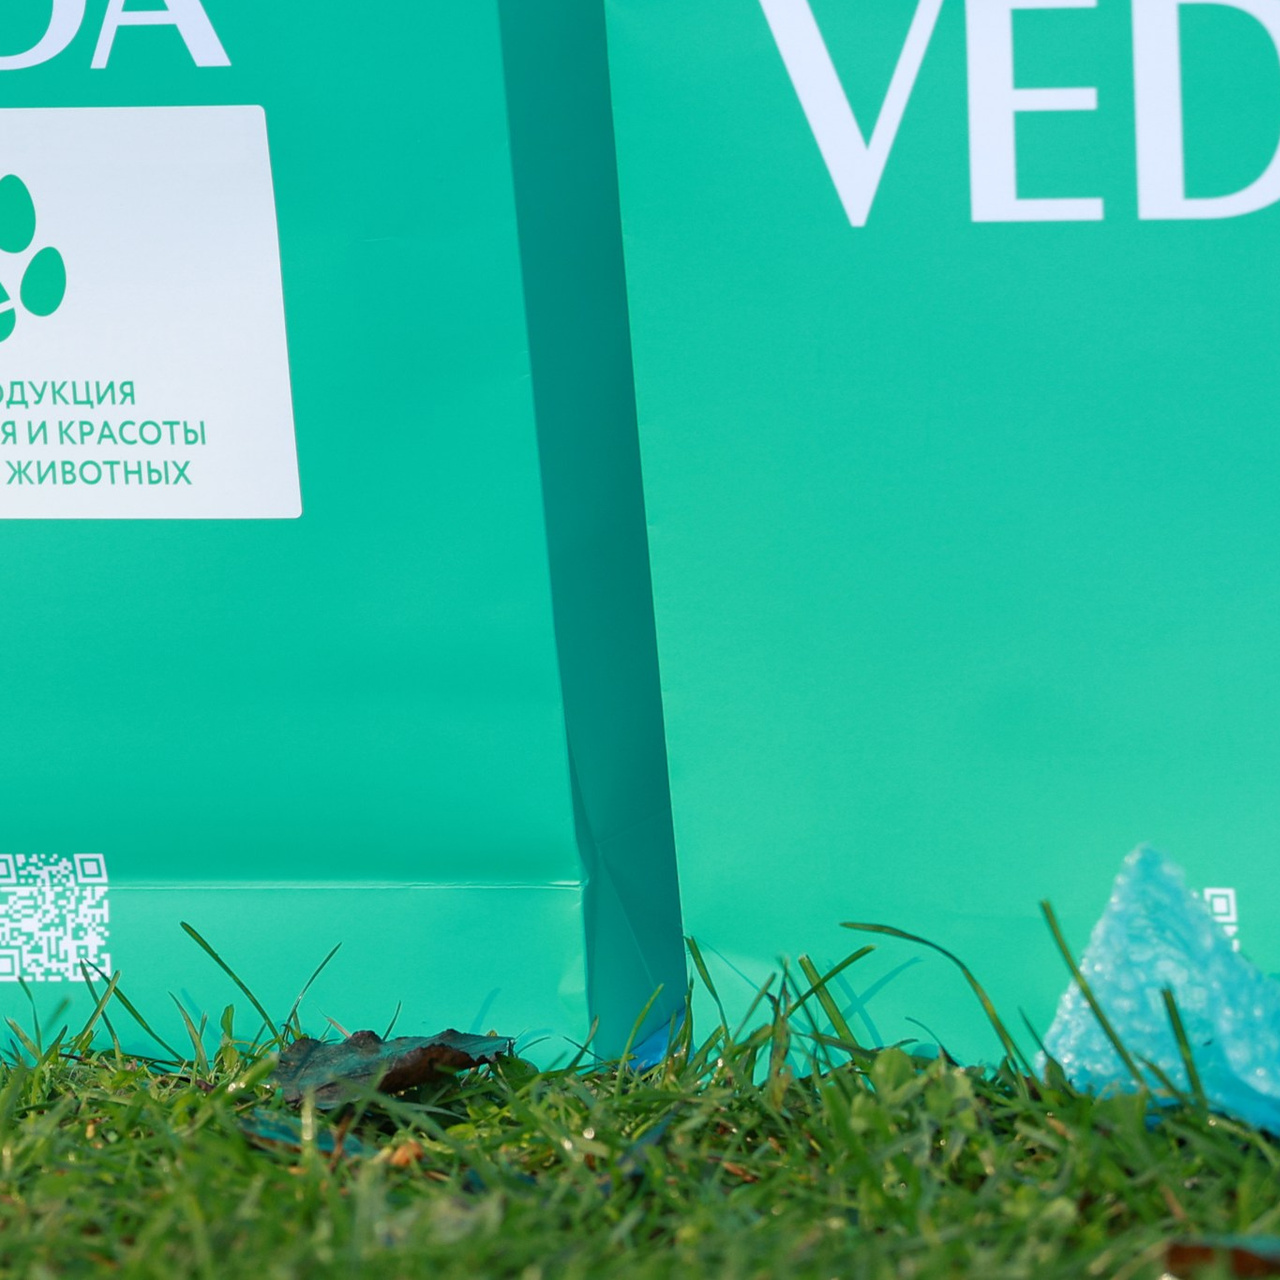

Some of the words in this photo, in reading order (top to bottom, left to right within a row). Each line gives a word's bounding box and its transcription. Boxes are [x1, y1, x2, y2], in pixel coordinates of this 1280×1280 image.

[27, 420, 48, 446] И
[58, 419, 207, 446] КРАСОТЫ
[6, 459, 193, 486] ЖИВОТНЫХ
